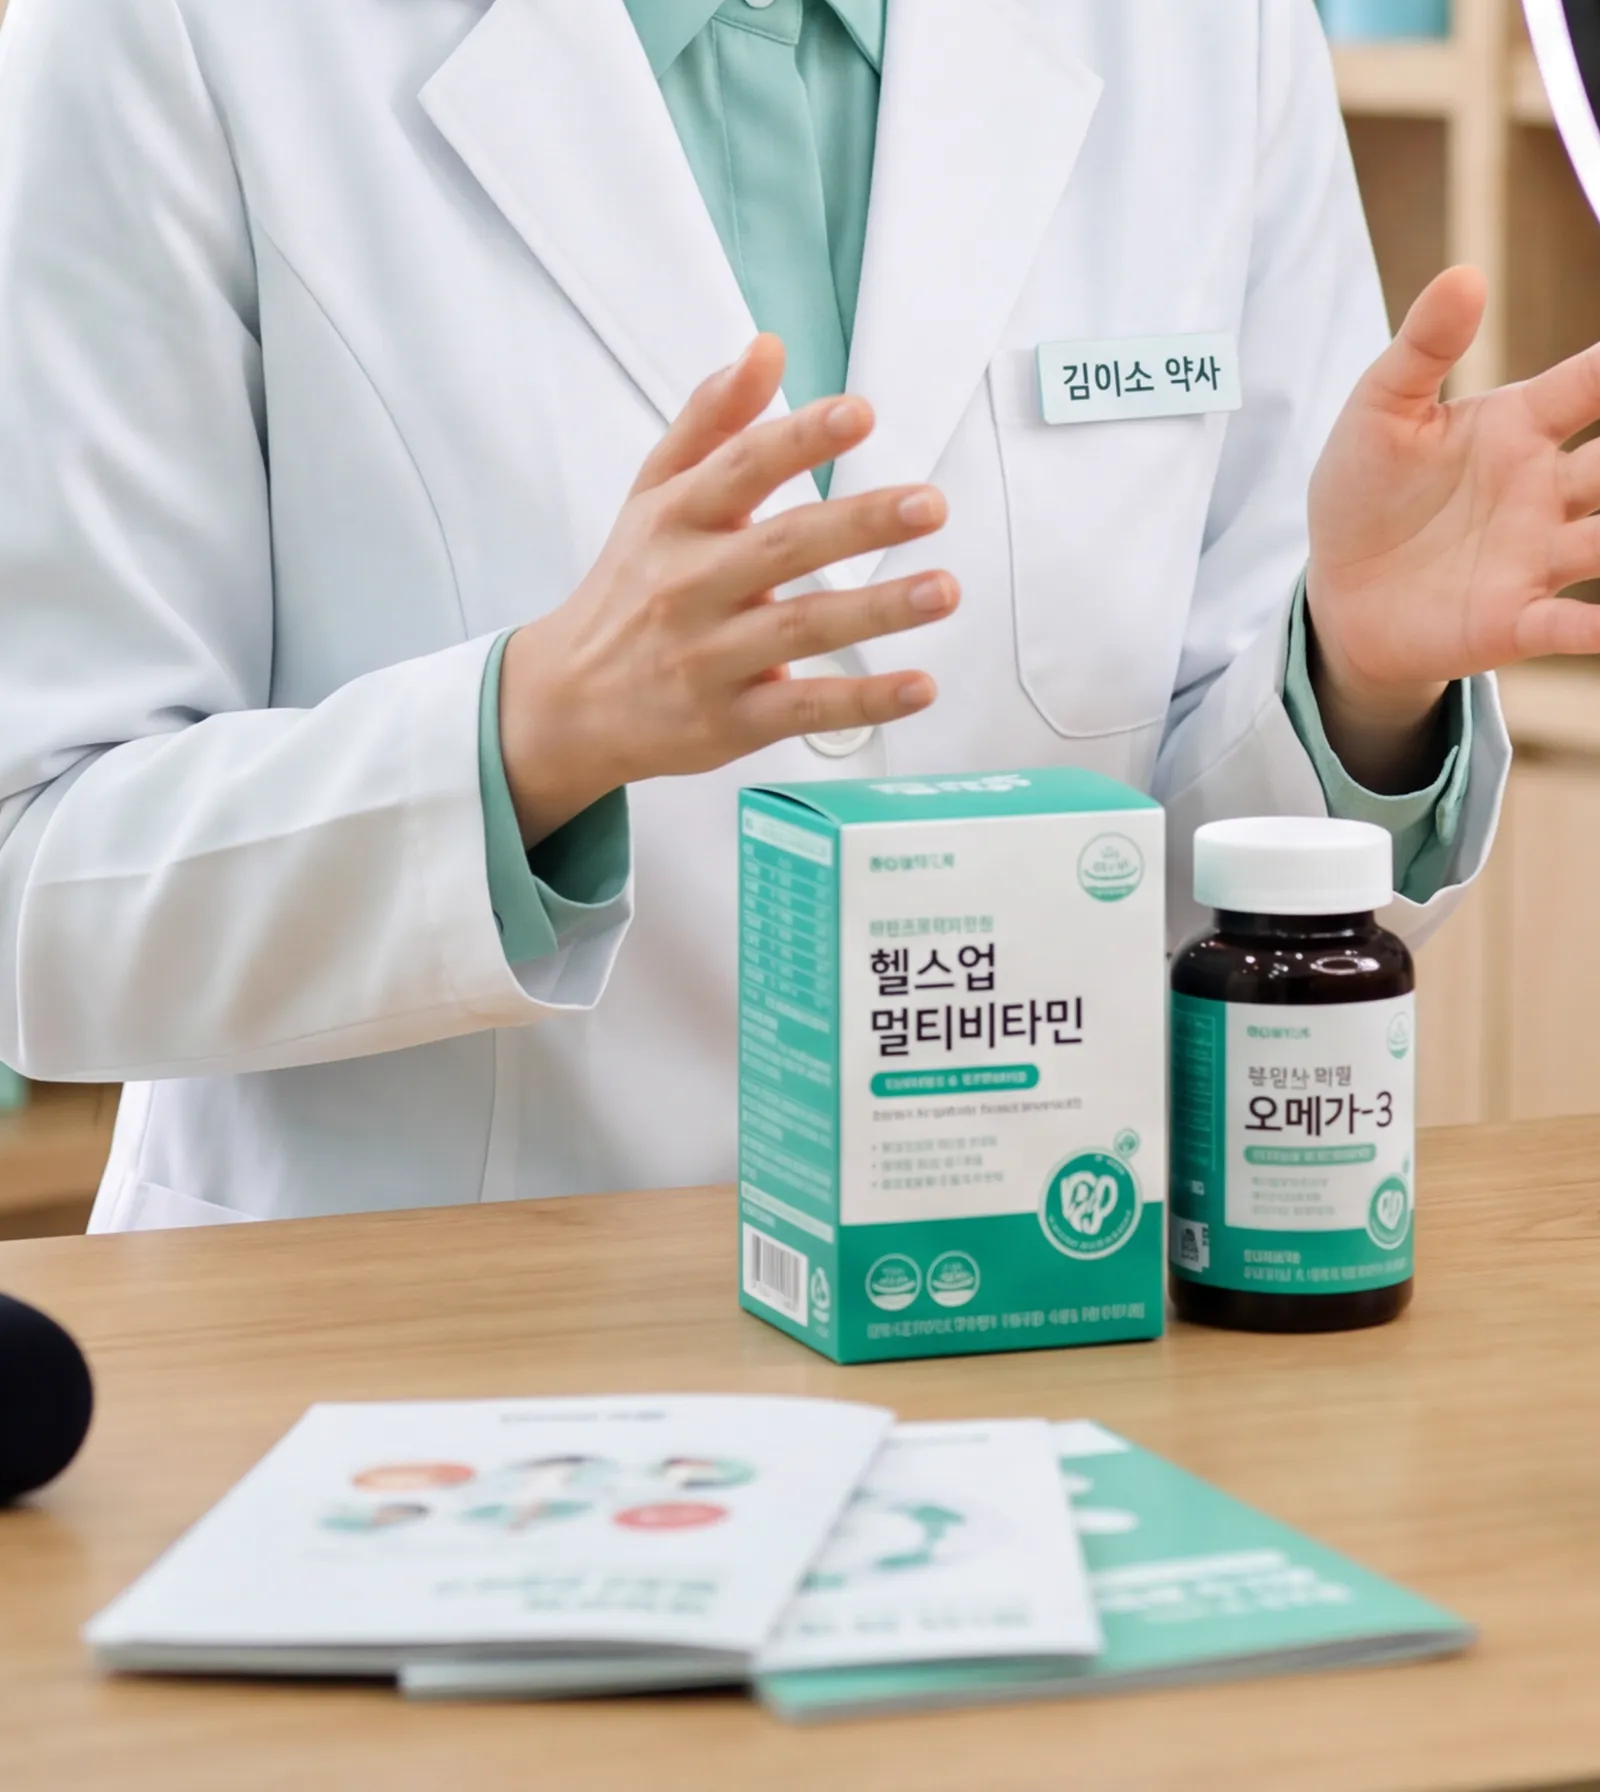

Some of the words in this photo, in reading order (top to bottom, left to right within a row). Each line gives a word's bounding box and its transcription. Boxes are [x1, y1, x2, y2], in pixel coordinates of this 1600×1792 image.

[1062, 360, 1154, 401] 김이소
[1165, 355, 1221, 392] 약사
[870, 942, 995, 996] 헬스업
[871, 996, 1083, 1057] 멀티비타민
[1245, 1091, 1393, 1136] 오메가-3
